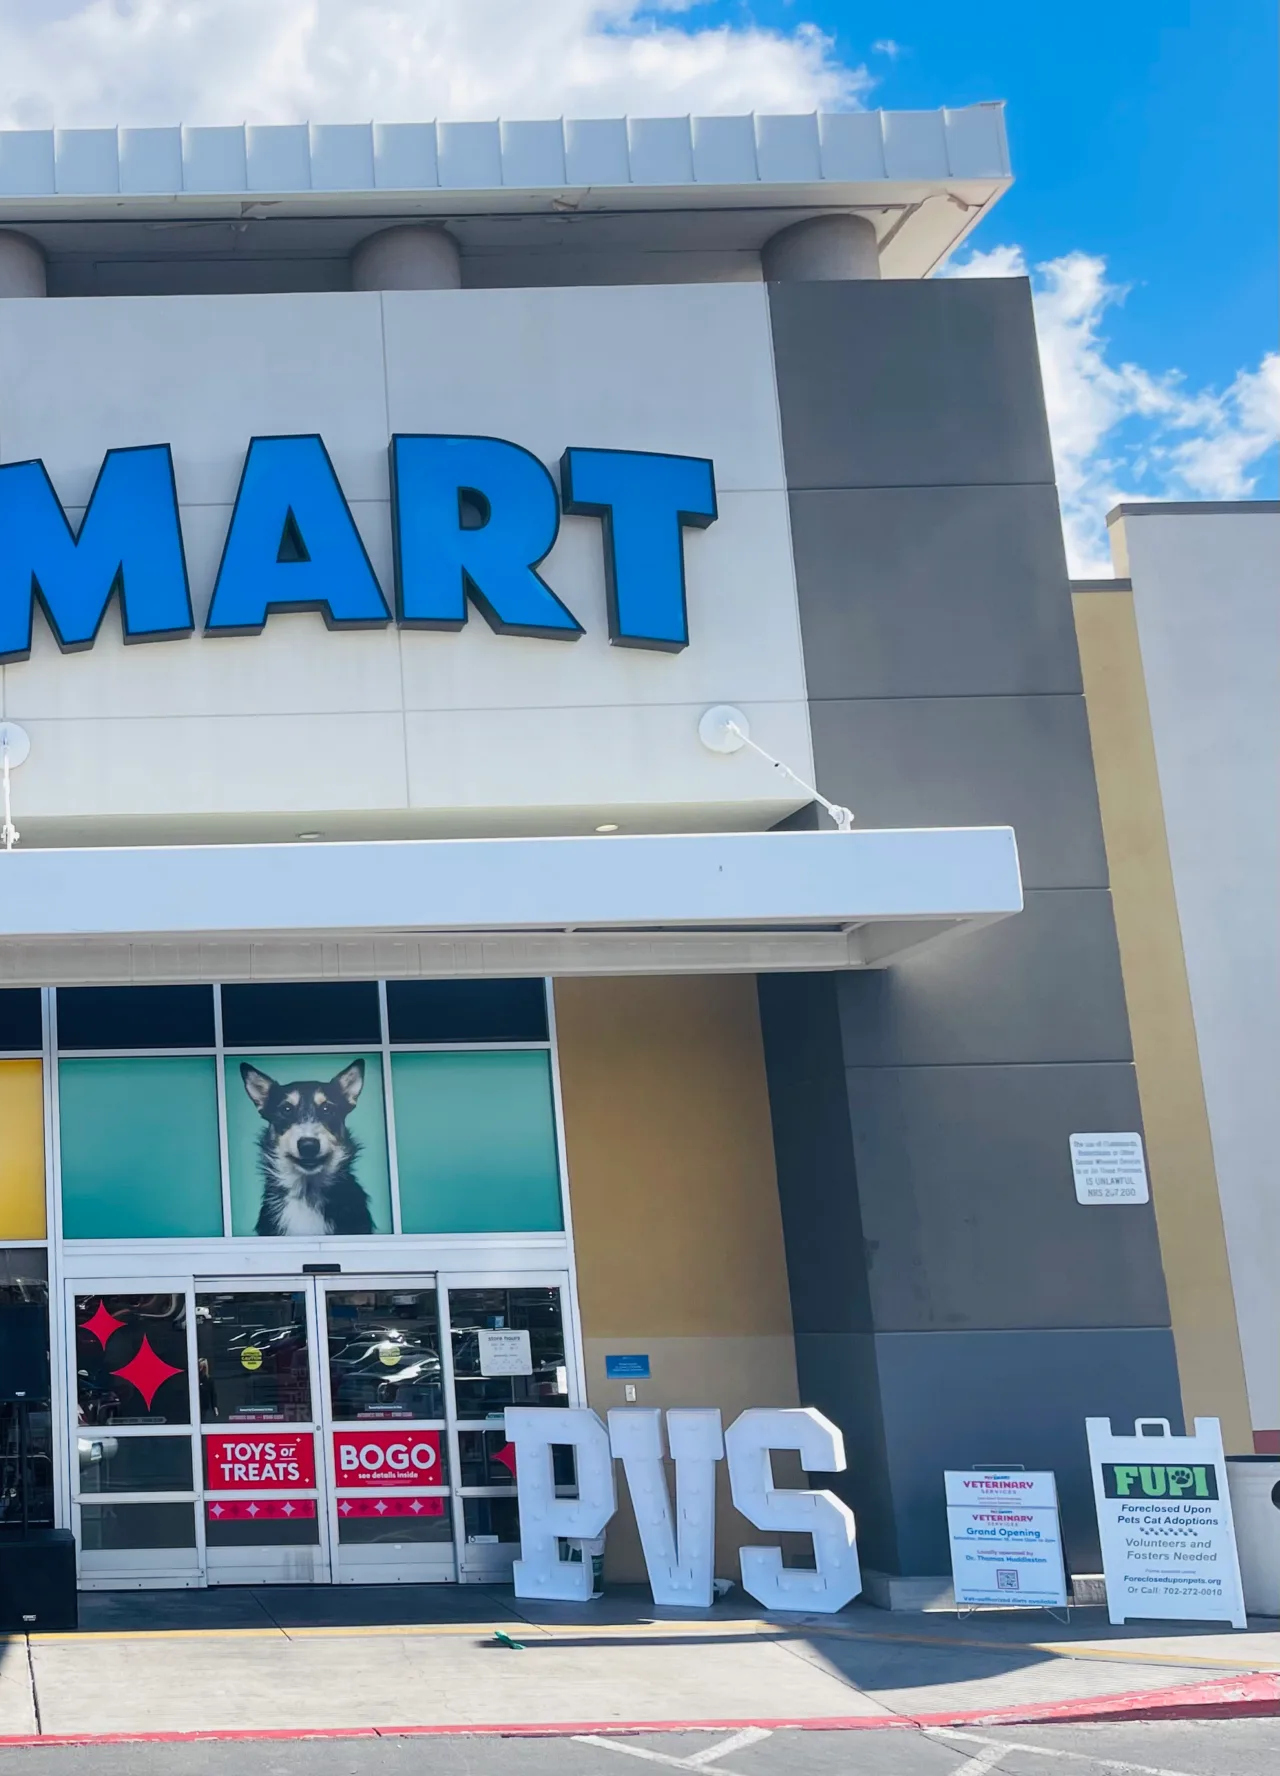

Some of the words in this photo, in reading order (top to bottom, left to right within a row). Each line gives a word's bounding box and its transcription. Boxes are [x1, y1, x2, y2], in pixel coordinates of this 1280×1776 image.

[222, 1442, 277, 1461] TOYS
[280, 1447, 296, 1457] or
[339, 1443, 436, 1471] BOGO
[220, 1462, 300, 1482] TREATS
[372, 1471, 396, 1479] details
[963, 1481, 1034, 1489] VETERINARY
[1113, 1466, 1209, 1497] FUPI
[504, 1407, 862, 1614] PVS
[1121, 1504, 1180, 1513] Foreclosed
[1183, 1505, 1212, 1514] Upon
[972, 1514, 1034, 1522] VETERINARY
[1117, 1515, 1140, 1524] Pets
[1143, 1516, 1161, 1524] Cat
[1164, 1516, 1218, 1526] Adoptions
[966, 1527, 996, 1536] Grand
[999, 1528, 1041, 1538] Opening
[1125, 1538, 1186, 1548] Volunteers
[1190, 1540, 1212, 1549] and
[1127, 1550, 1170, 1560] Fosters
[1173, 1552, 1217, 1561] Needed
[1127, 1586, 1138, 1594] Or
[1163, 1587, 1223, 1596] 702-272-0010
